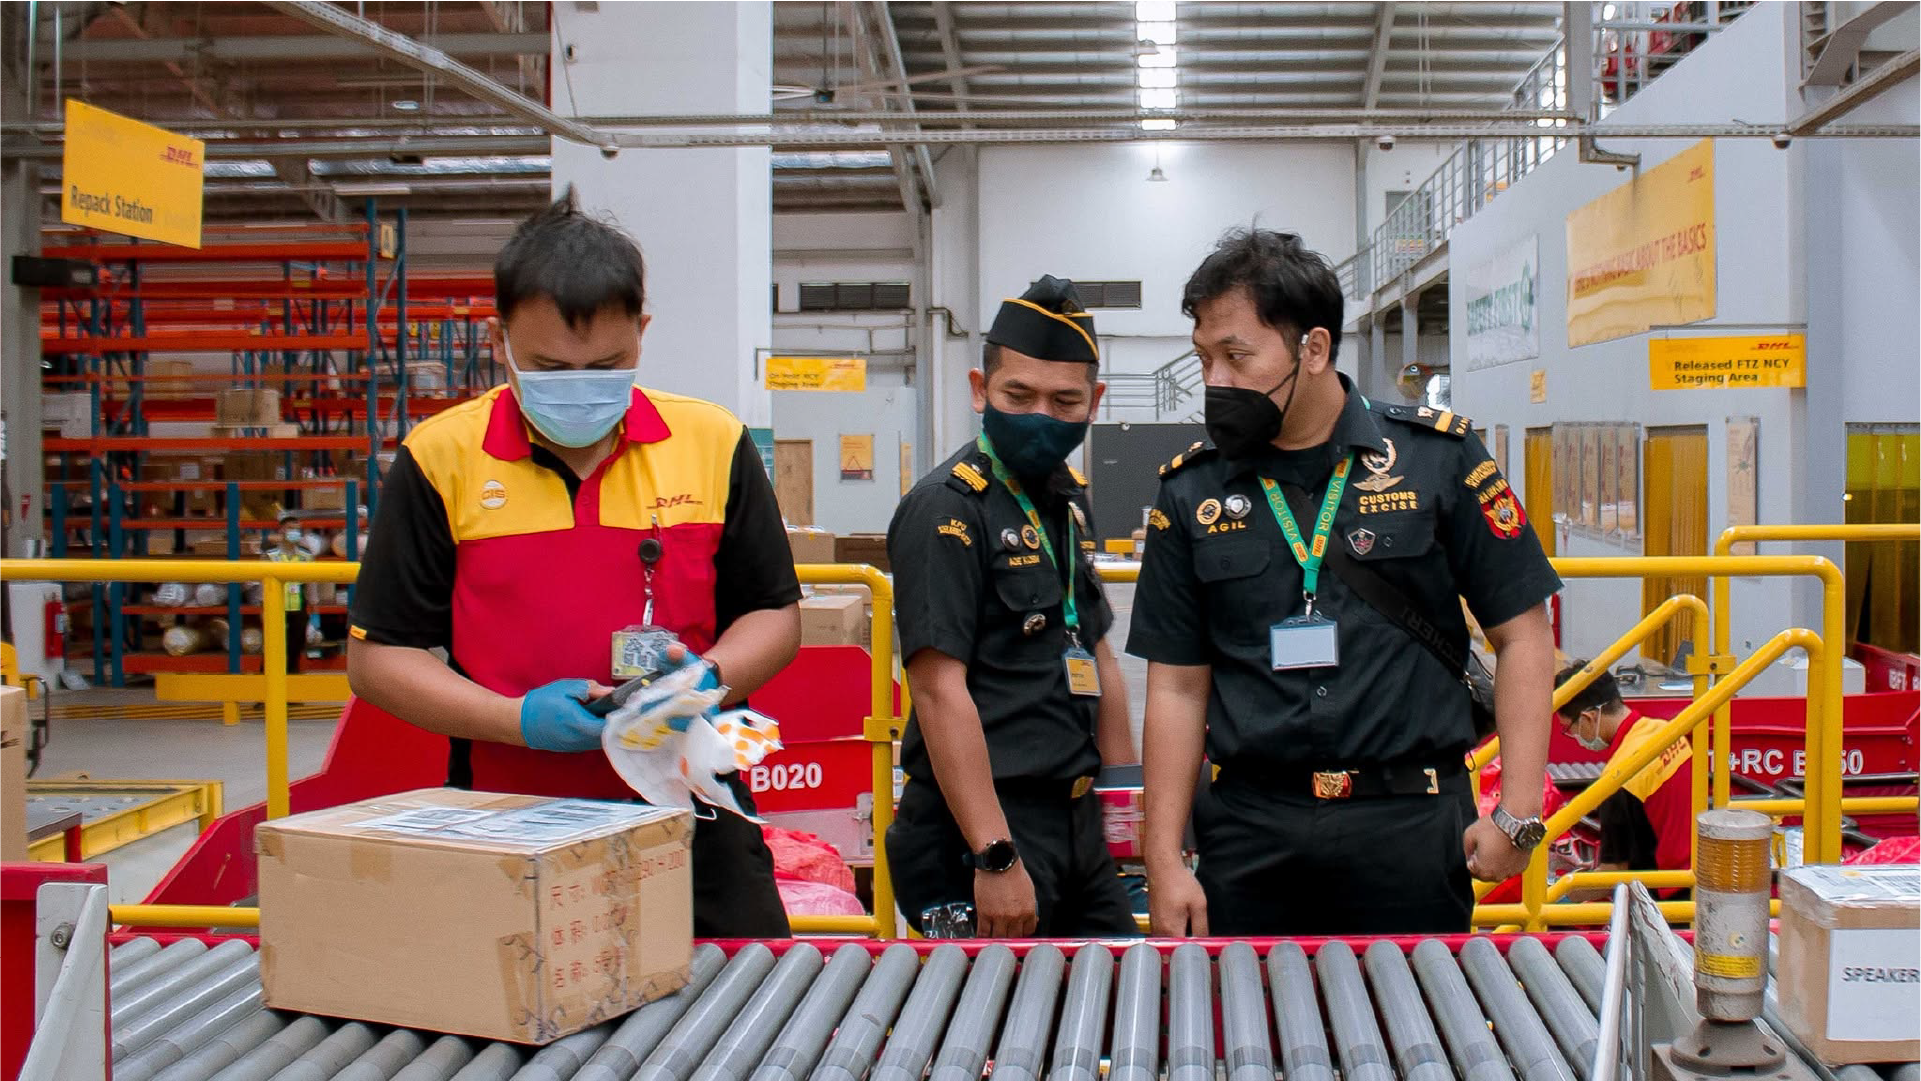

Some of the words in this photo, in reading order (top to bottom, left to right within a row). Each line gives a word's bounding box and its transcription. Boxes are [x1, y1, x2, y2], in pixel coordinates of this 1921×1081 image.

[71, 185, 111, 217] Repack
[115, 195, 153, 224] Station
[1674, 359, 1732, 371] Released
[1737, 359, 1760, 369] FTZ
[1763, 358, 1790, 369] NCY
[1674, 374, 1725, 386] Staging
[1729, 373, 1758, 382] Area
[650, 494, 697, 509] DHL
[1359, 491, 1417, 505] CUSTOMS
[1317, 480, 1342, 532] VISITOR
[1359, 500, 1418, 514] EXCISE
[1269, 492, 1299, 541] VISITOR
[1207, 521, 1246, 534] AGIL
[750, 762, 823, 793] B020
